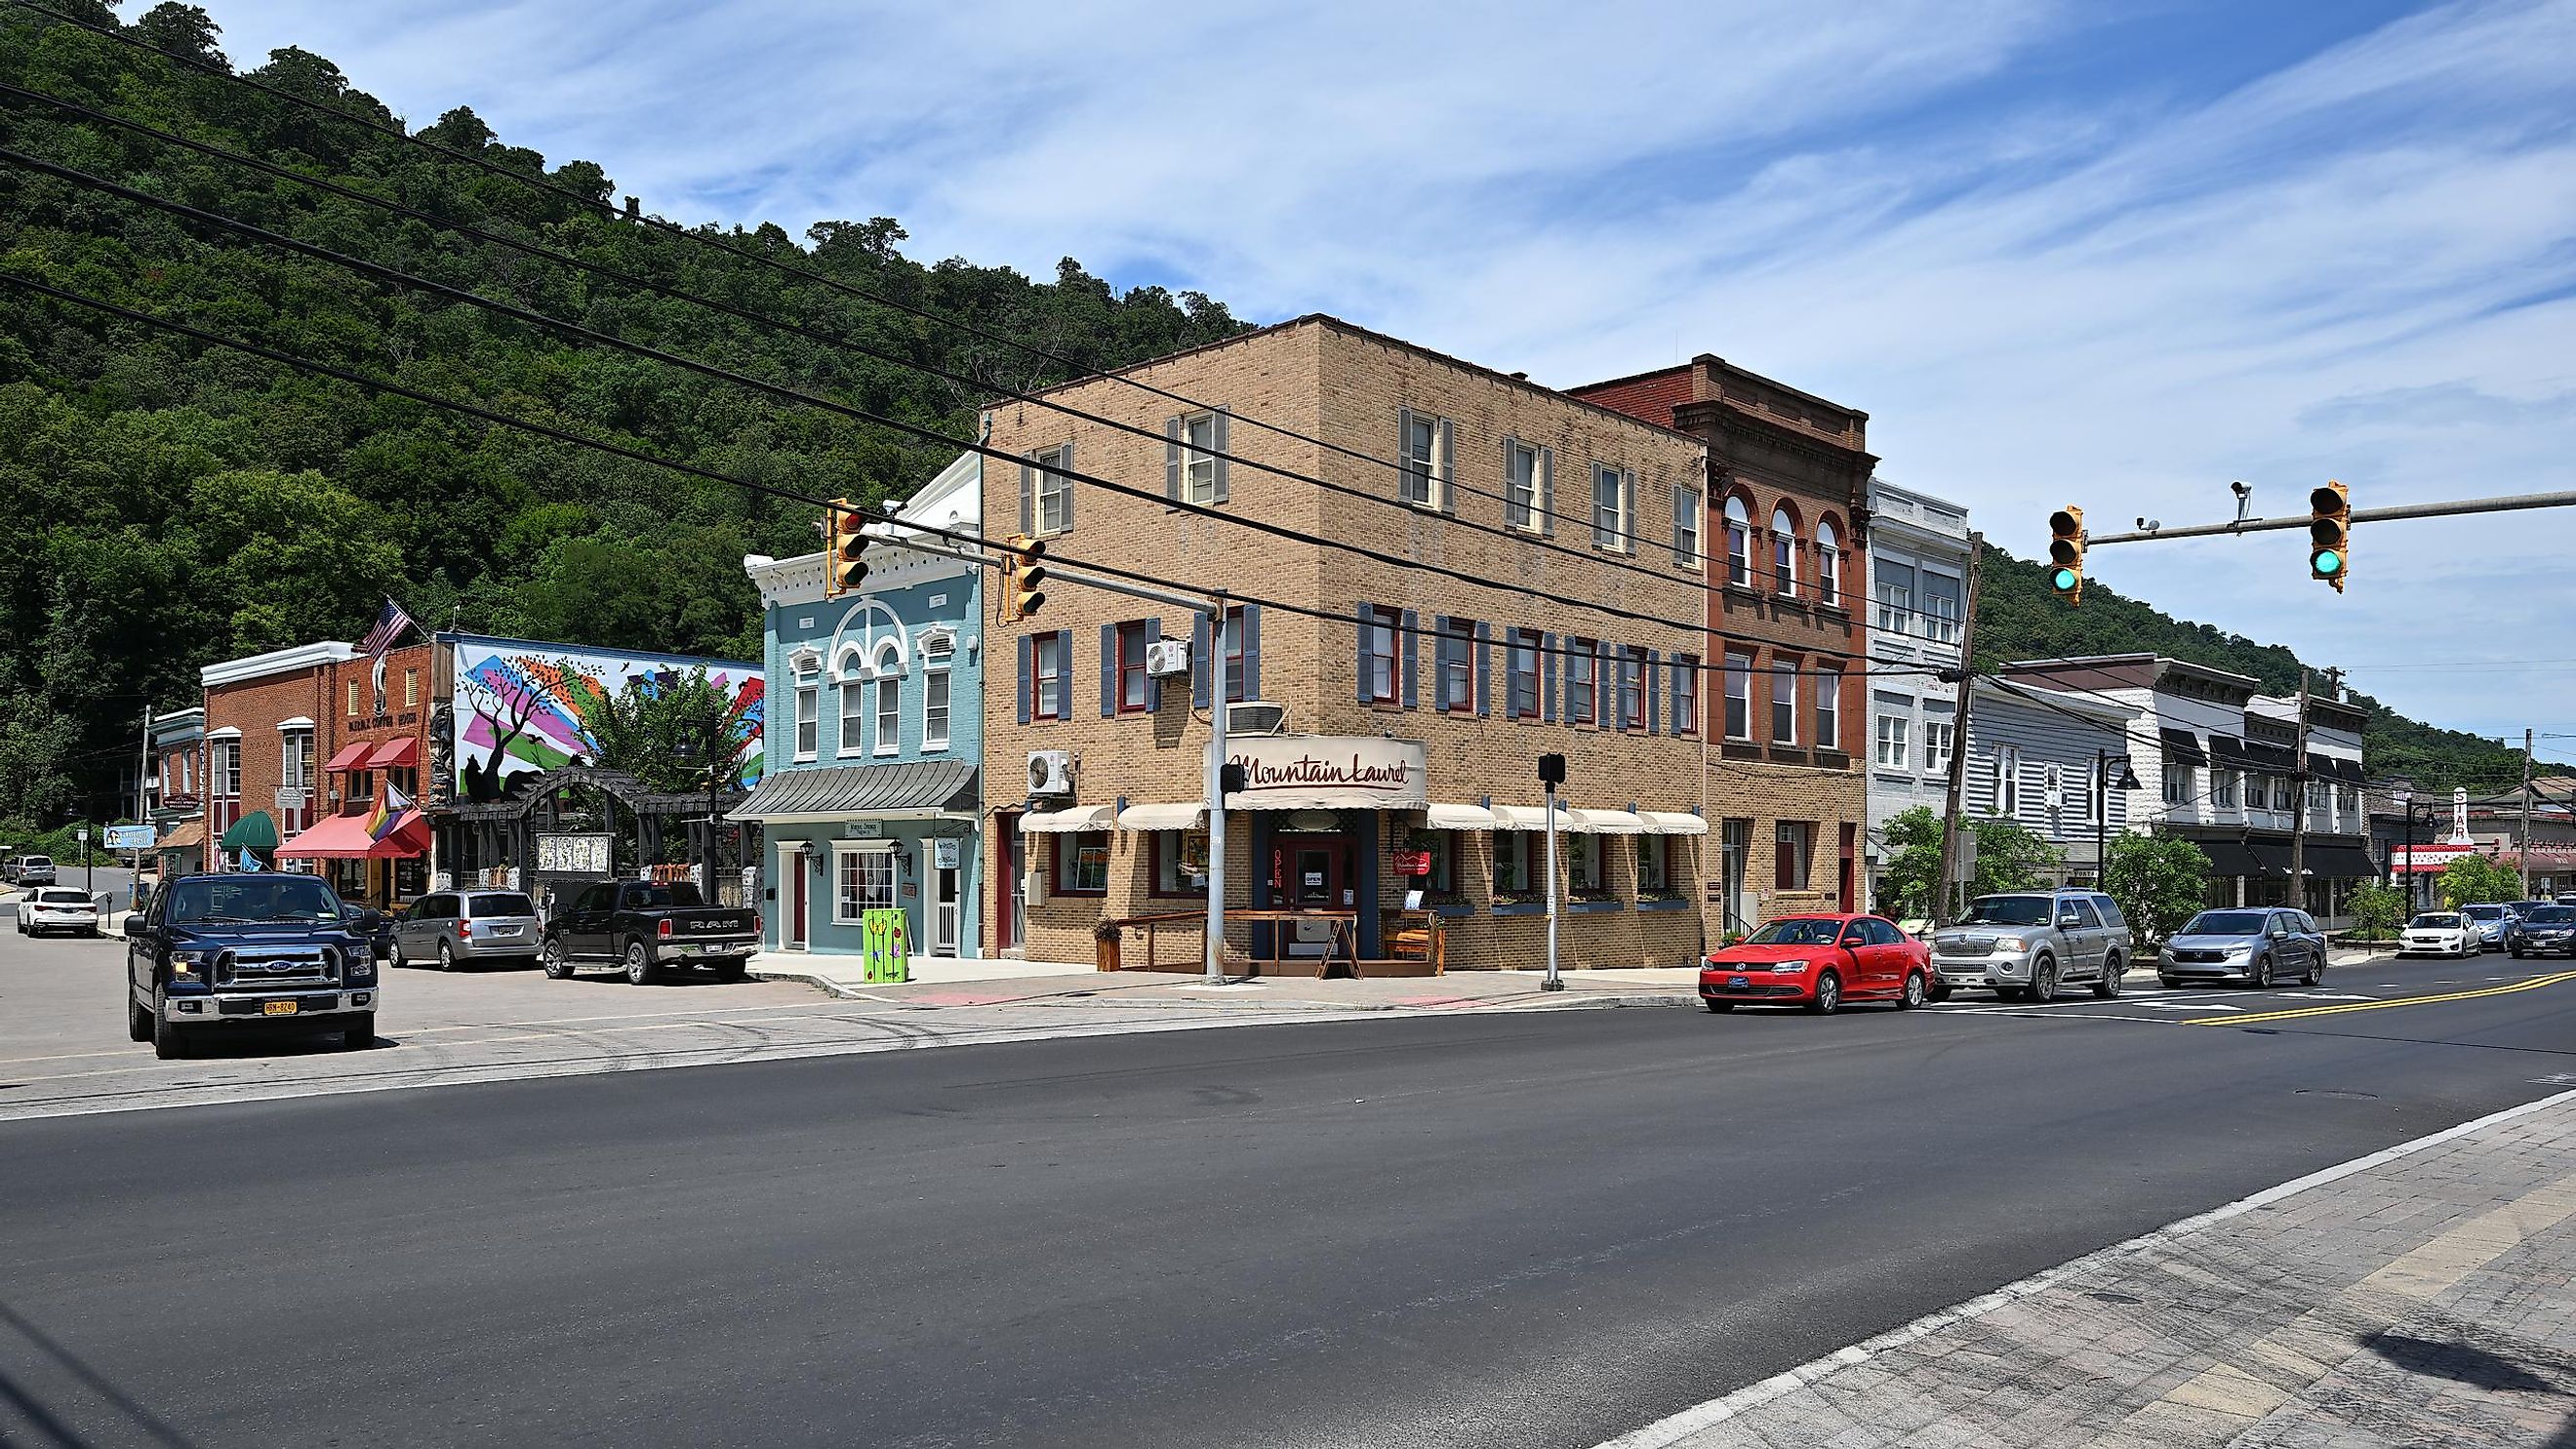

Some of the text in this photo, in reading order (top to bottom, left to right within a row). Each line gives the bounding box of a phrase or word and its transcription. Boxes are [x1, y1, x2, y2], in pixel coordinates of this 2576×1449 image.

[1229, 753, 1409, 785] Mountain Laurel
[2455, 793, 2465, 838] STAR
[690, 920, 739, 929] RAM
